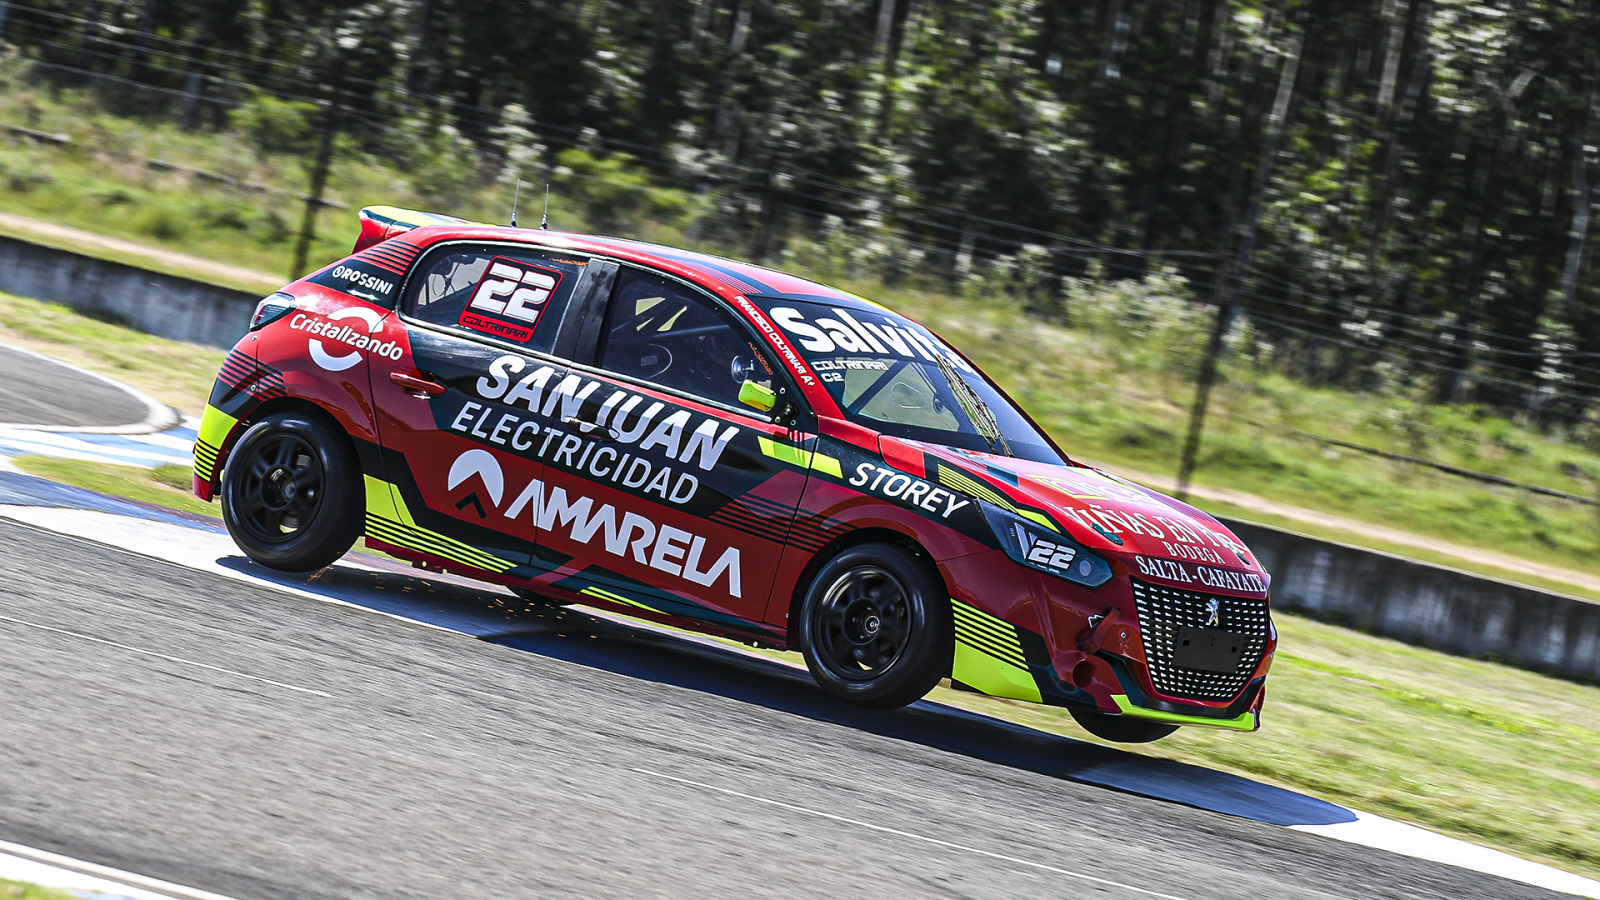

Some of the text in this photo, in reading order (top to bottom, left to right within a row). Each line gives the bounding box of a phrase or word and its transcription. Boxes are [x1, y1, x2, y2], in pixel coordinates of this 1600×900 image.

[469, 261, 556, 324] 22
[462, 315, 530, 339] COLTRINARI
[733, 295, 774, 334] FRANCISCO
[768, 332, 807, 374] COLTRINARI
[810, 360, 890, 371] COLTRINARI
[820, 372, 845, 383] C2
[475, 354, 740, 471] SAN JUAN
[450, 401, 700, 505] ELECTRICIDAD
[848, 462, 971, 519] STOREY
[503, 478, 742, 599] AMARELA
[1062, 503, 1166, 540] VIÑAS
[1152, 515, 1206, 546] EN
[1134, 555, 1193, 585] SALTA
[1199, 566, 1267, 593] CAFAYATE
[1161, 540, 1226, 565] BODEGA
